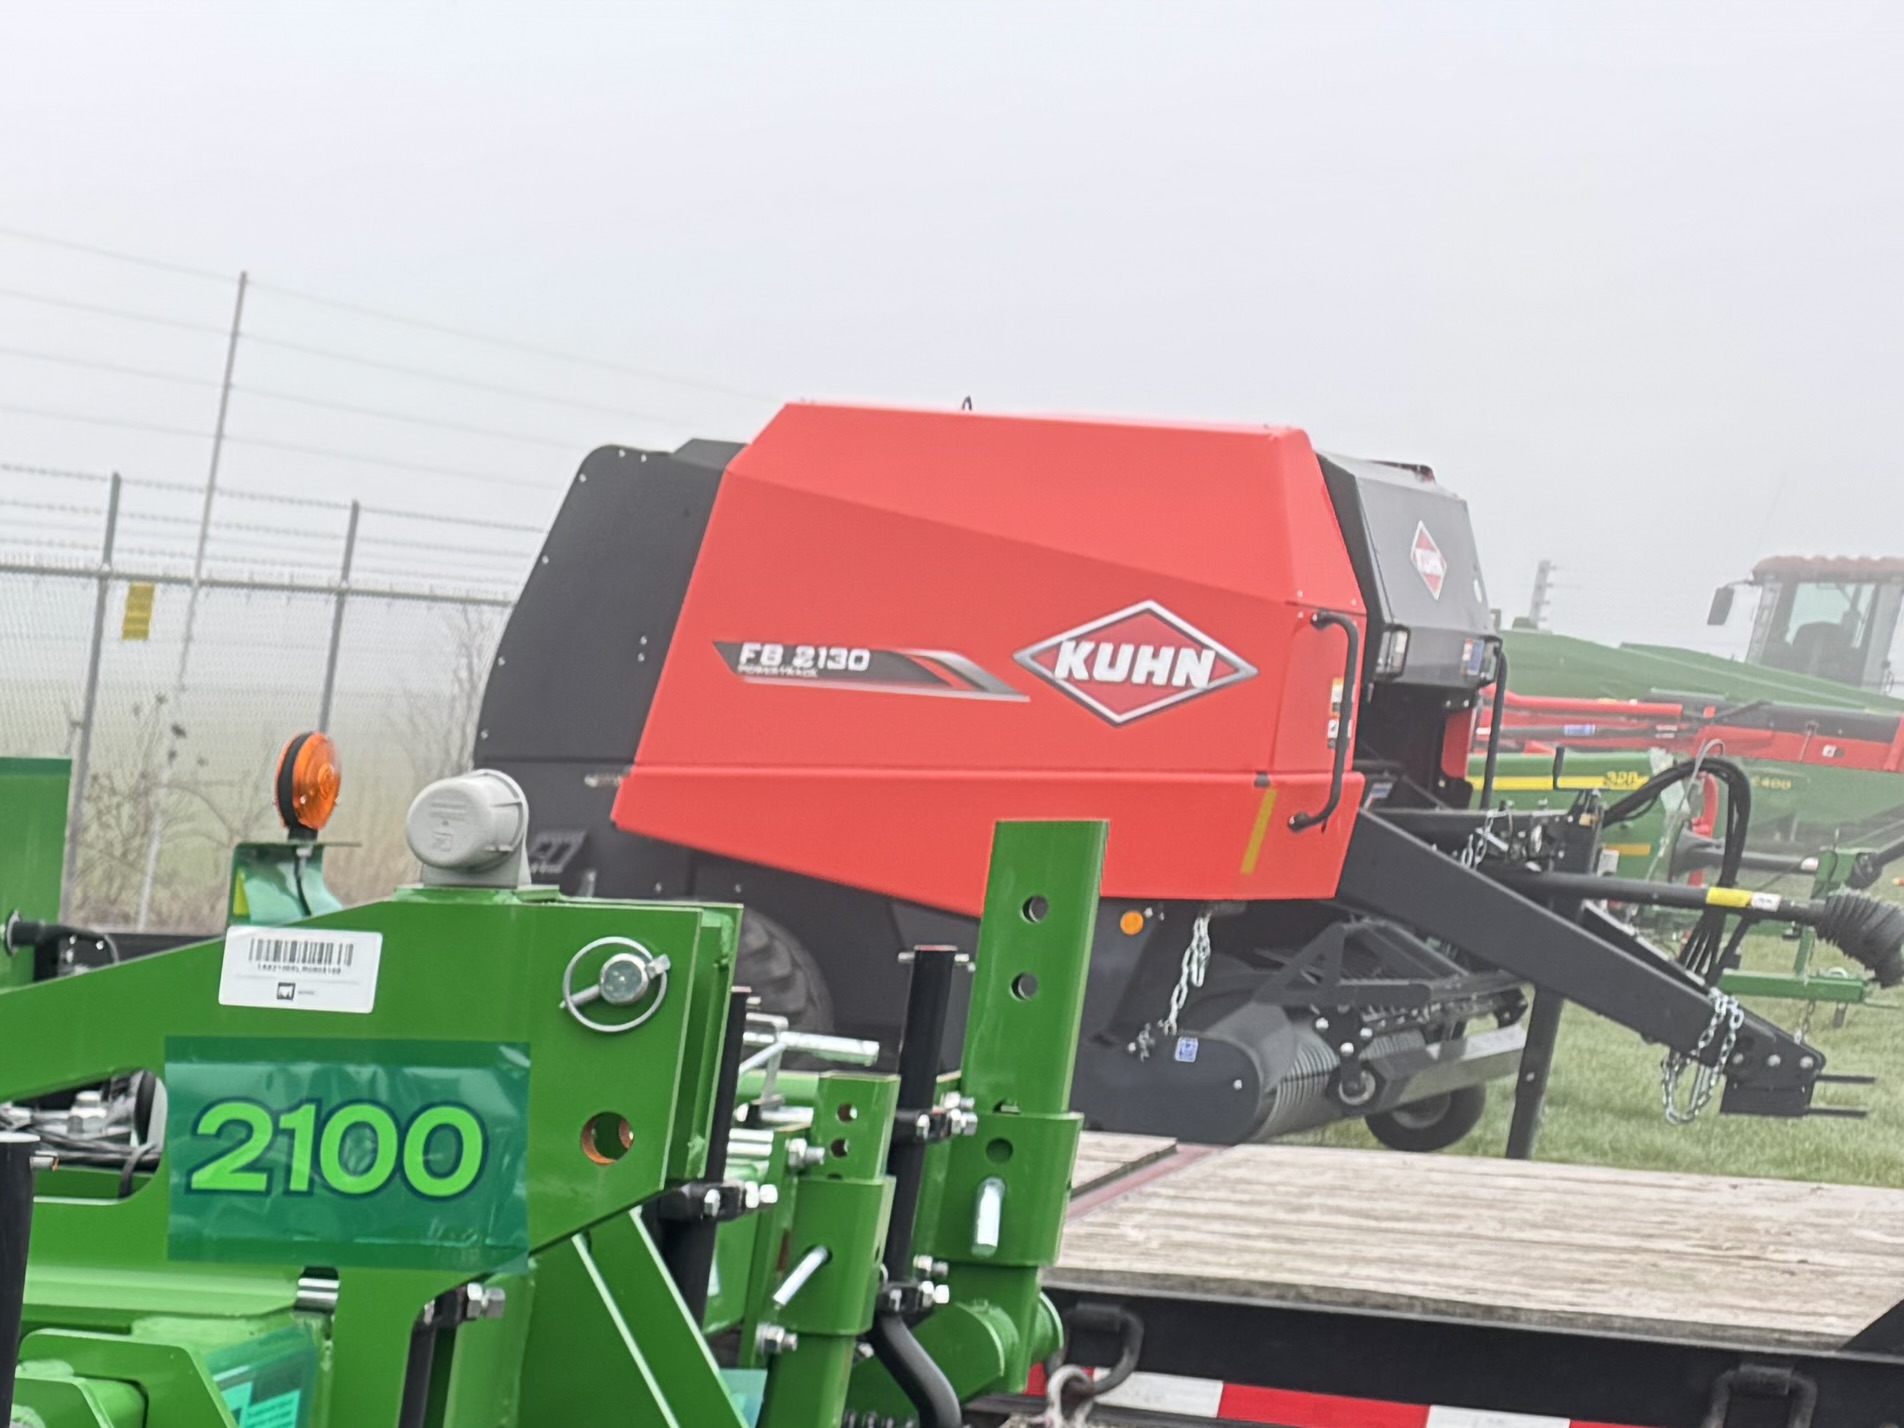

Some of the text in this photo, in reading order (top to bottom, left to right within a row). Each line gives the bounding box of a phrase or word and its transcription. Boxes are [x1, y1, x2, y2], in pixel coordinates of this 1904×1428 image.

[739, 642, 871, 671] FB 2130
[1055, 640, 1216, 688] KUHN
[189, 1100, 484, 1198] 2100
